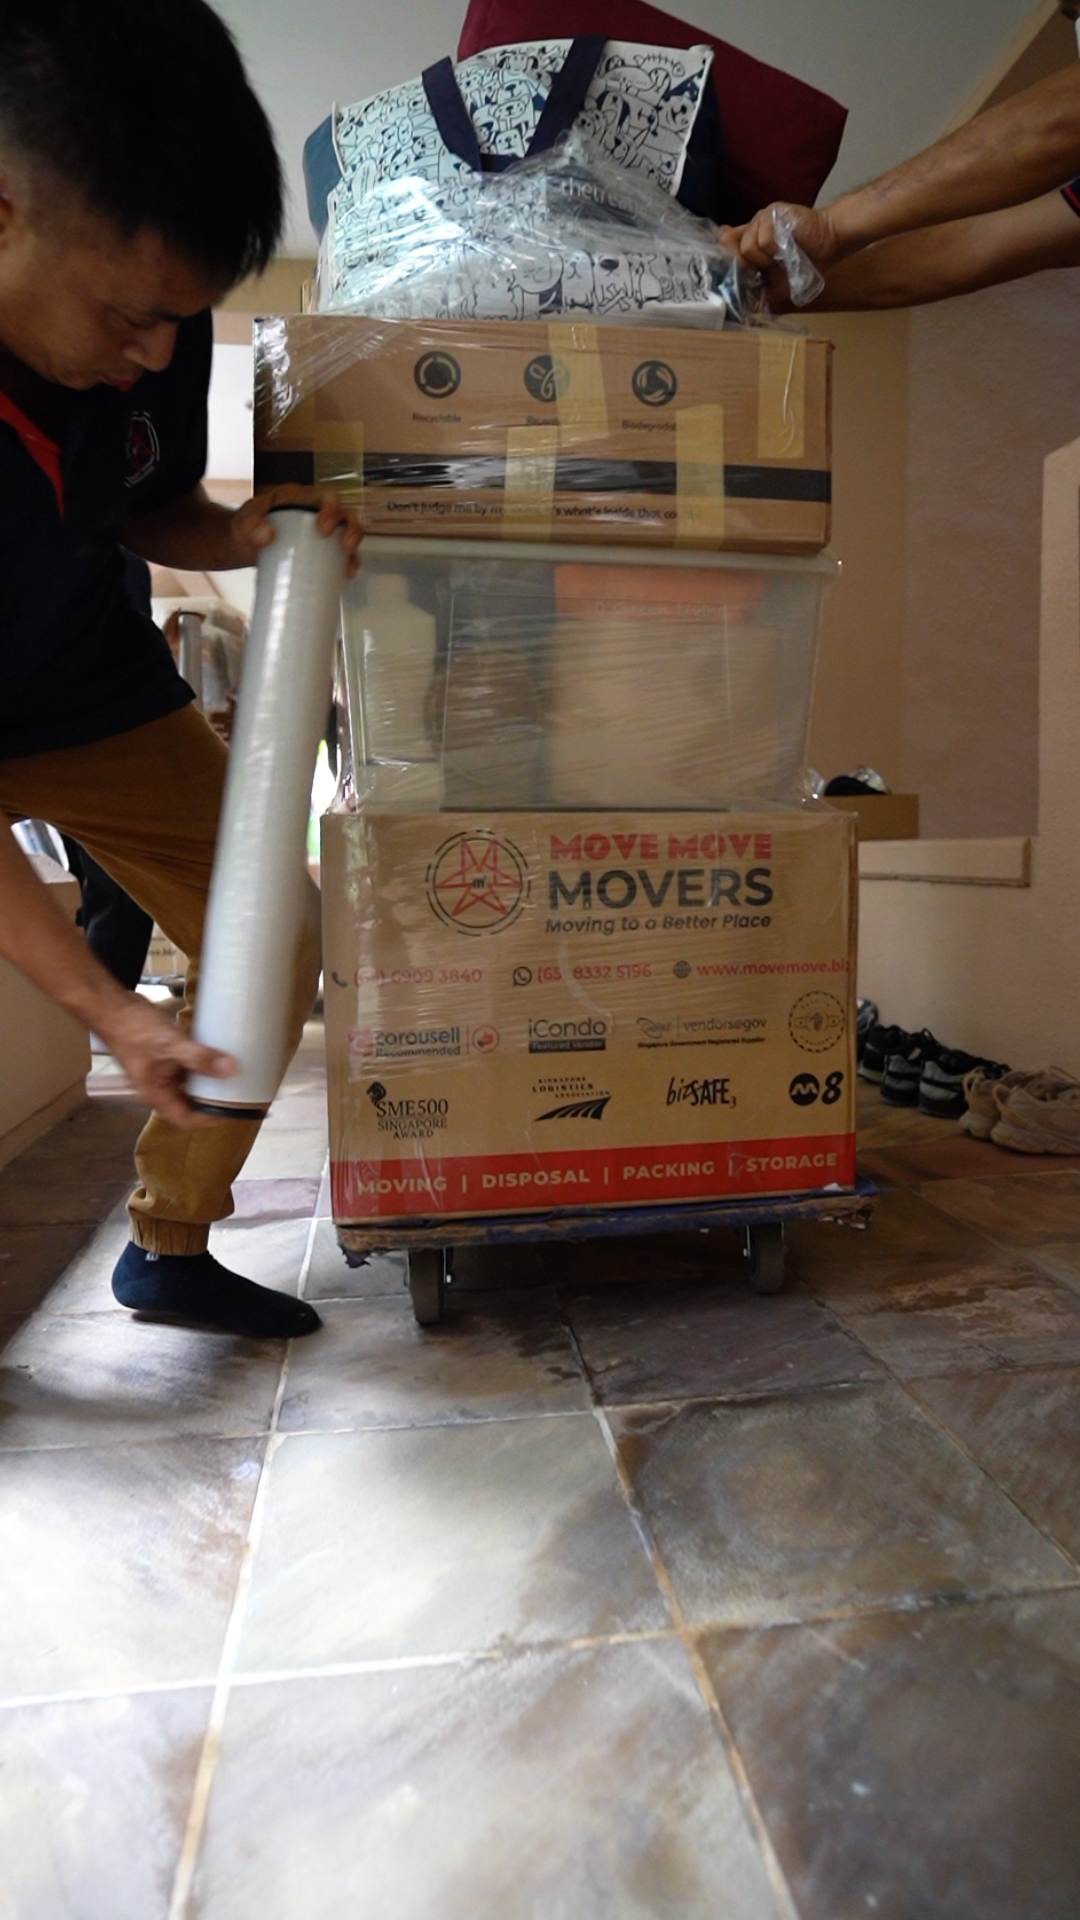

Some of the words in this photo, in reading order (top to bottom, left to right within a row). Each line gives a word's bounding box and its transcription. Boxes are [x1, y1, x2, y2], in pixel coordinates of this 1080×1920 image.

[412, 412, 462, 423] Recyclable
[387, 501, 419, 513] Don't
[550, 833, 659, 861] MOVE
[668, 833, 773, 861] MOVE
[548, 867, 774, 910] MOVERS
[545, 915, 615, 935] Moving
[621, 916, 639, 930] to
[645, 918, 657, 930] a
[662, 914, 717, 930] Better
[722, 914, 772, 929] Place
[439, 968, 483, 983] 3840
[537, 966, 562, 984] (65
[572, 966, 612, 980] 8332
[616, 964, 652, 978] 5196
[528, 1017, 606, 1038] iCondo
[532, 1083, 594, 1093] LOGISTICS
[376, 1098, 448, 1118] SME500
[377, 1118, 448, 1131] SINGAPORE
[393, 1130, 434, 1140] AWARD
[357, 1176, 447, 1195] MOVING
[482, 1169, 590, 1189] DISPOSAL
[623, 1160, 715, 1180] PACKING
[746, 1153, 837, 1173] STORAGE
